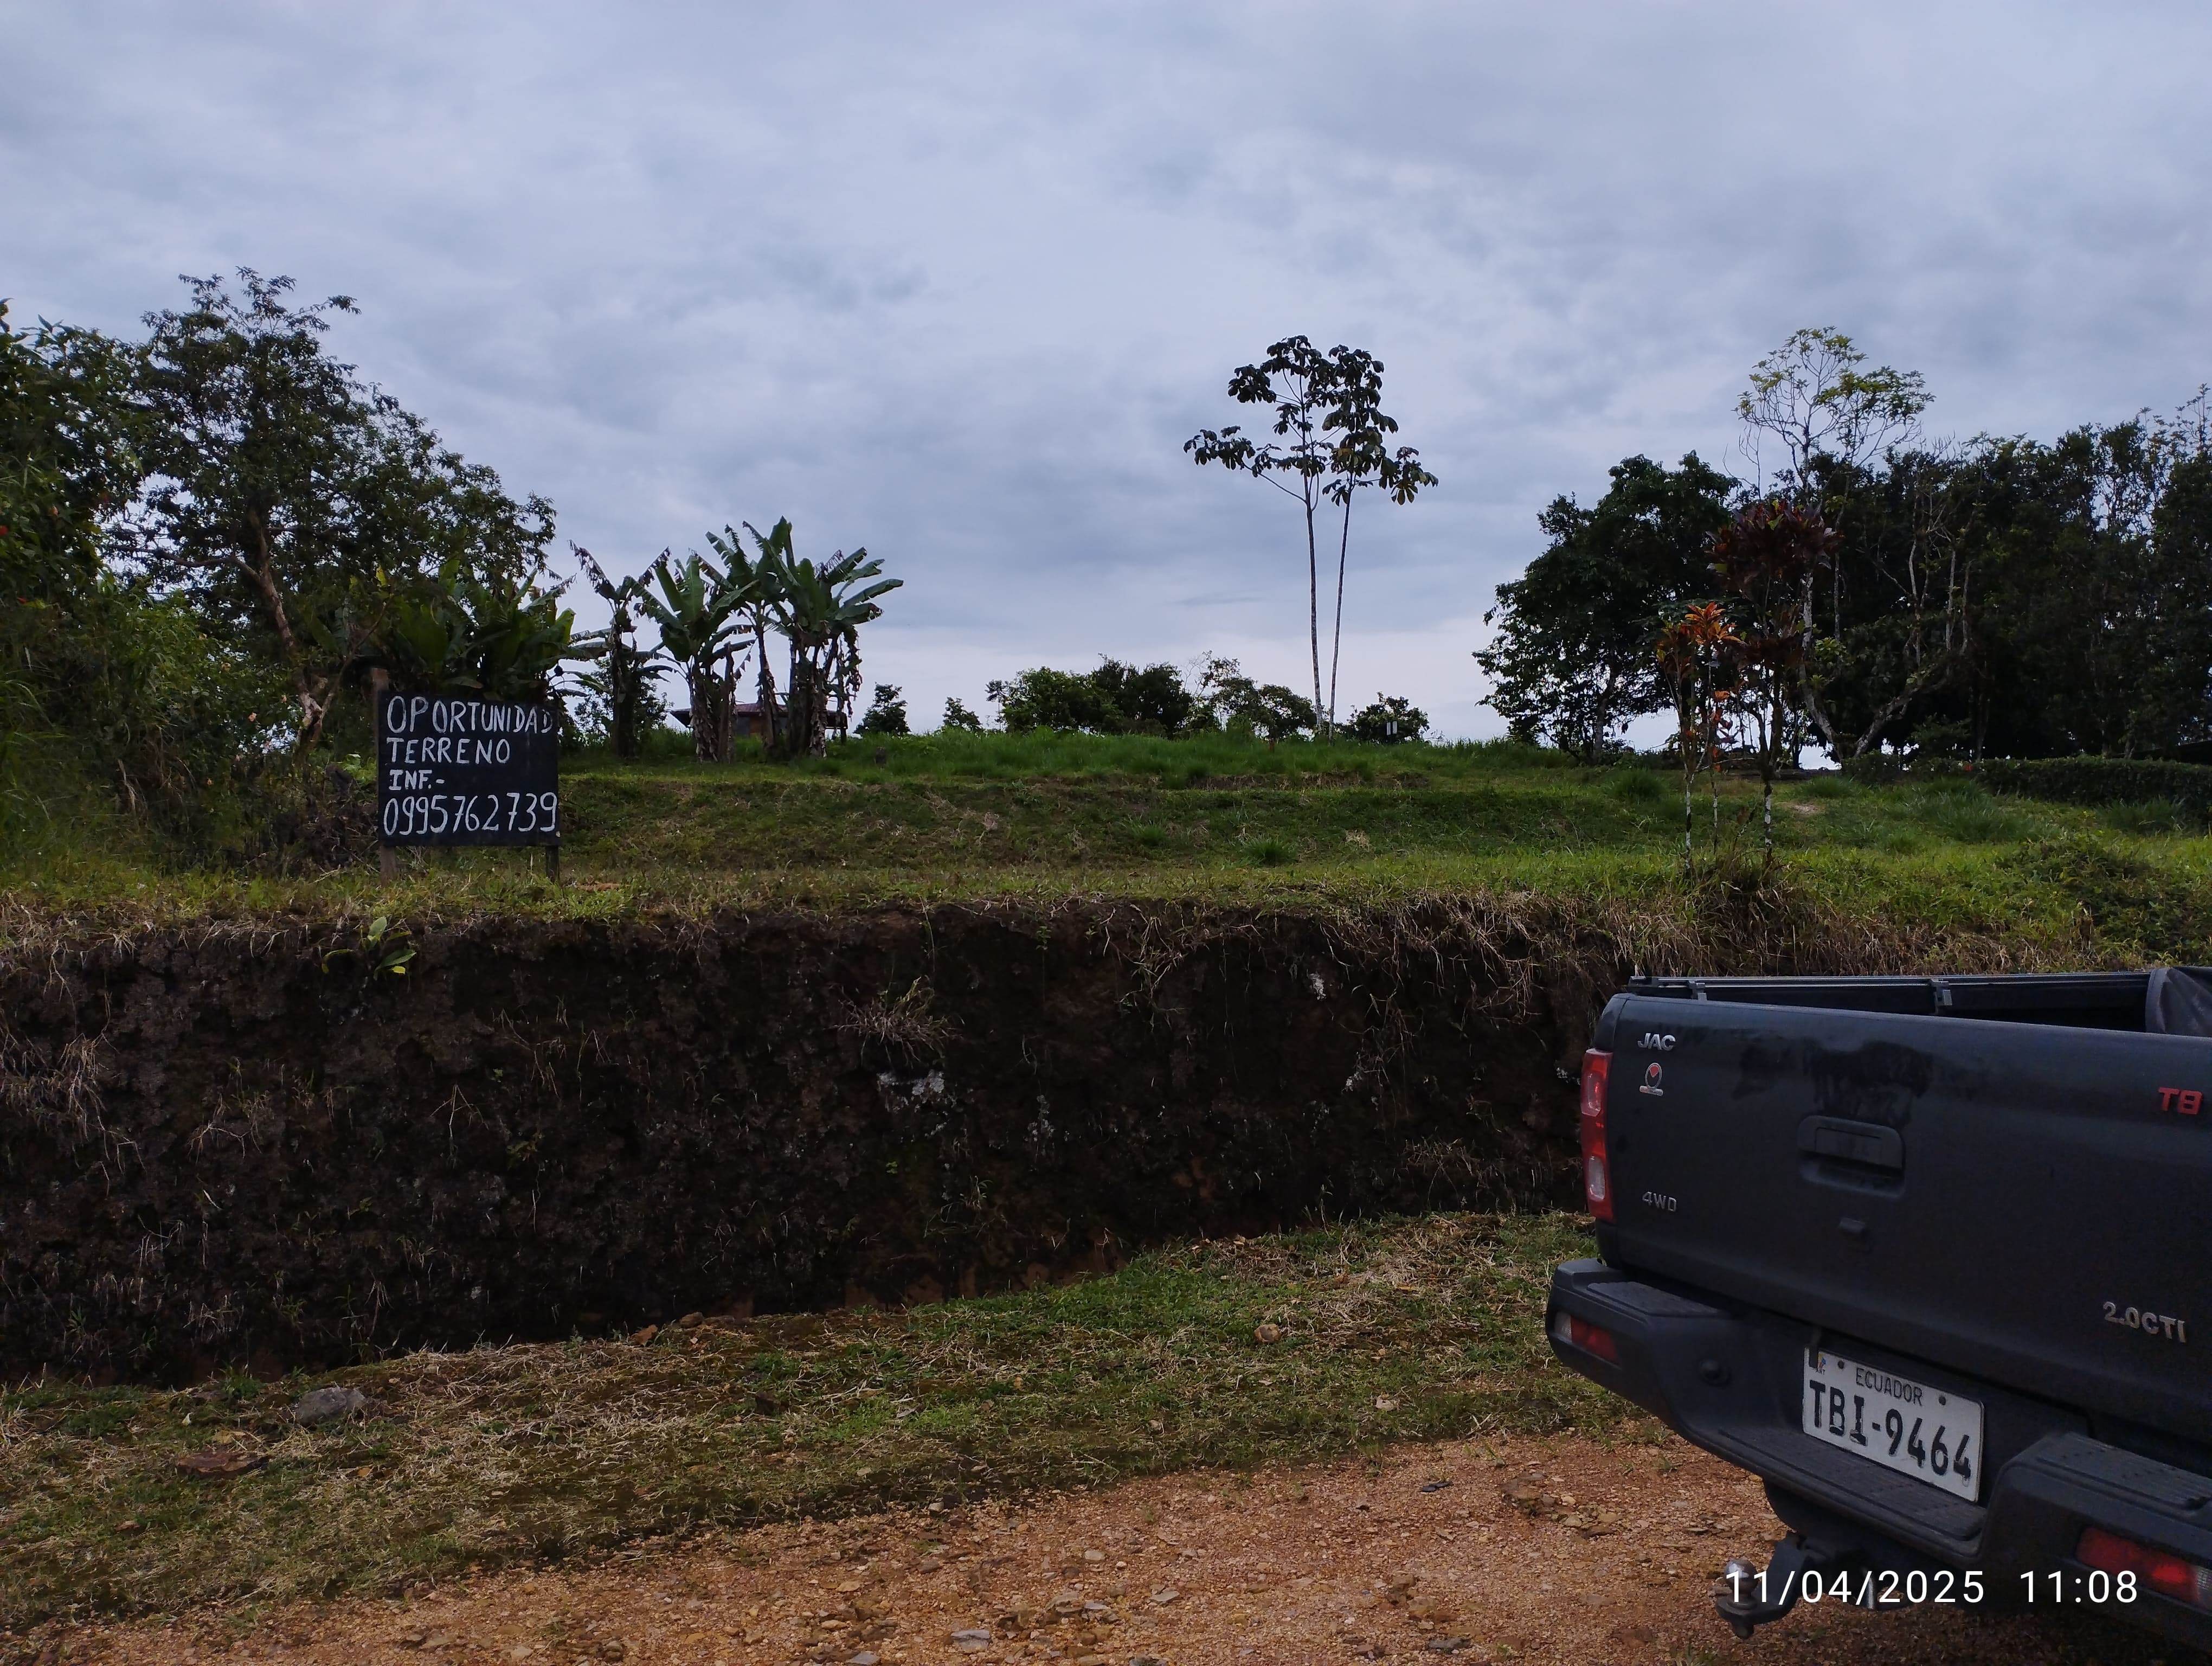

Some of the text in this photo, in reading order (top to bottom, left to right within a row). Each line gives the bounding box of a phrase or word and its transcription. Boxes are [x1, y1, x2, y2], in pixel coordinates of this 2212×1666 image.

[387, 696, 553, 734] OPORTUNIDAD
[387, 737, 510, 764] TERRENO
[384, 792, 558, 836] 0995762739
[1637, 1033, 1676, 1051] JAC
[2157, 1086, 2203, 1116] T8
[1642, 1191, 1677, 1212] 4WD
[2102, 1301, 2187, 1343] 2.0CTI
[1856, 1368, 1923, 1406] ECUADOR
[1809, 1380, 1972, 1485] TBI-9464
